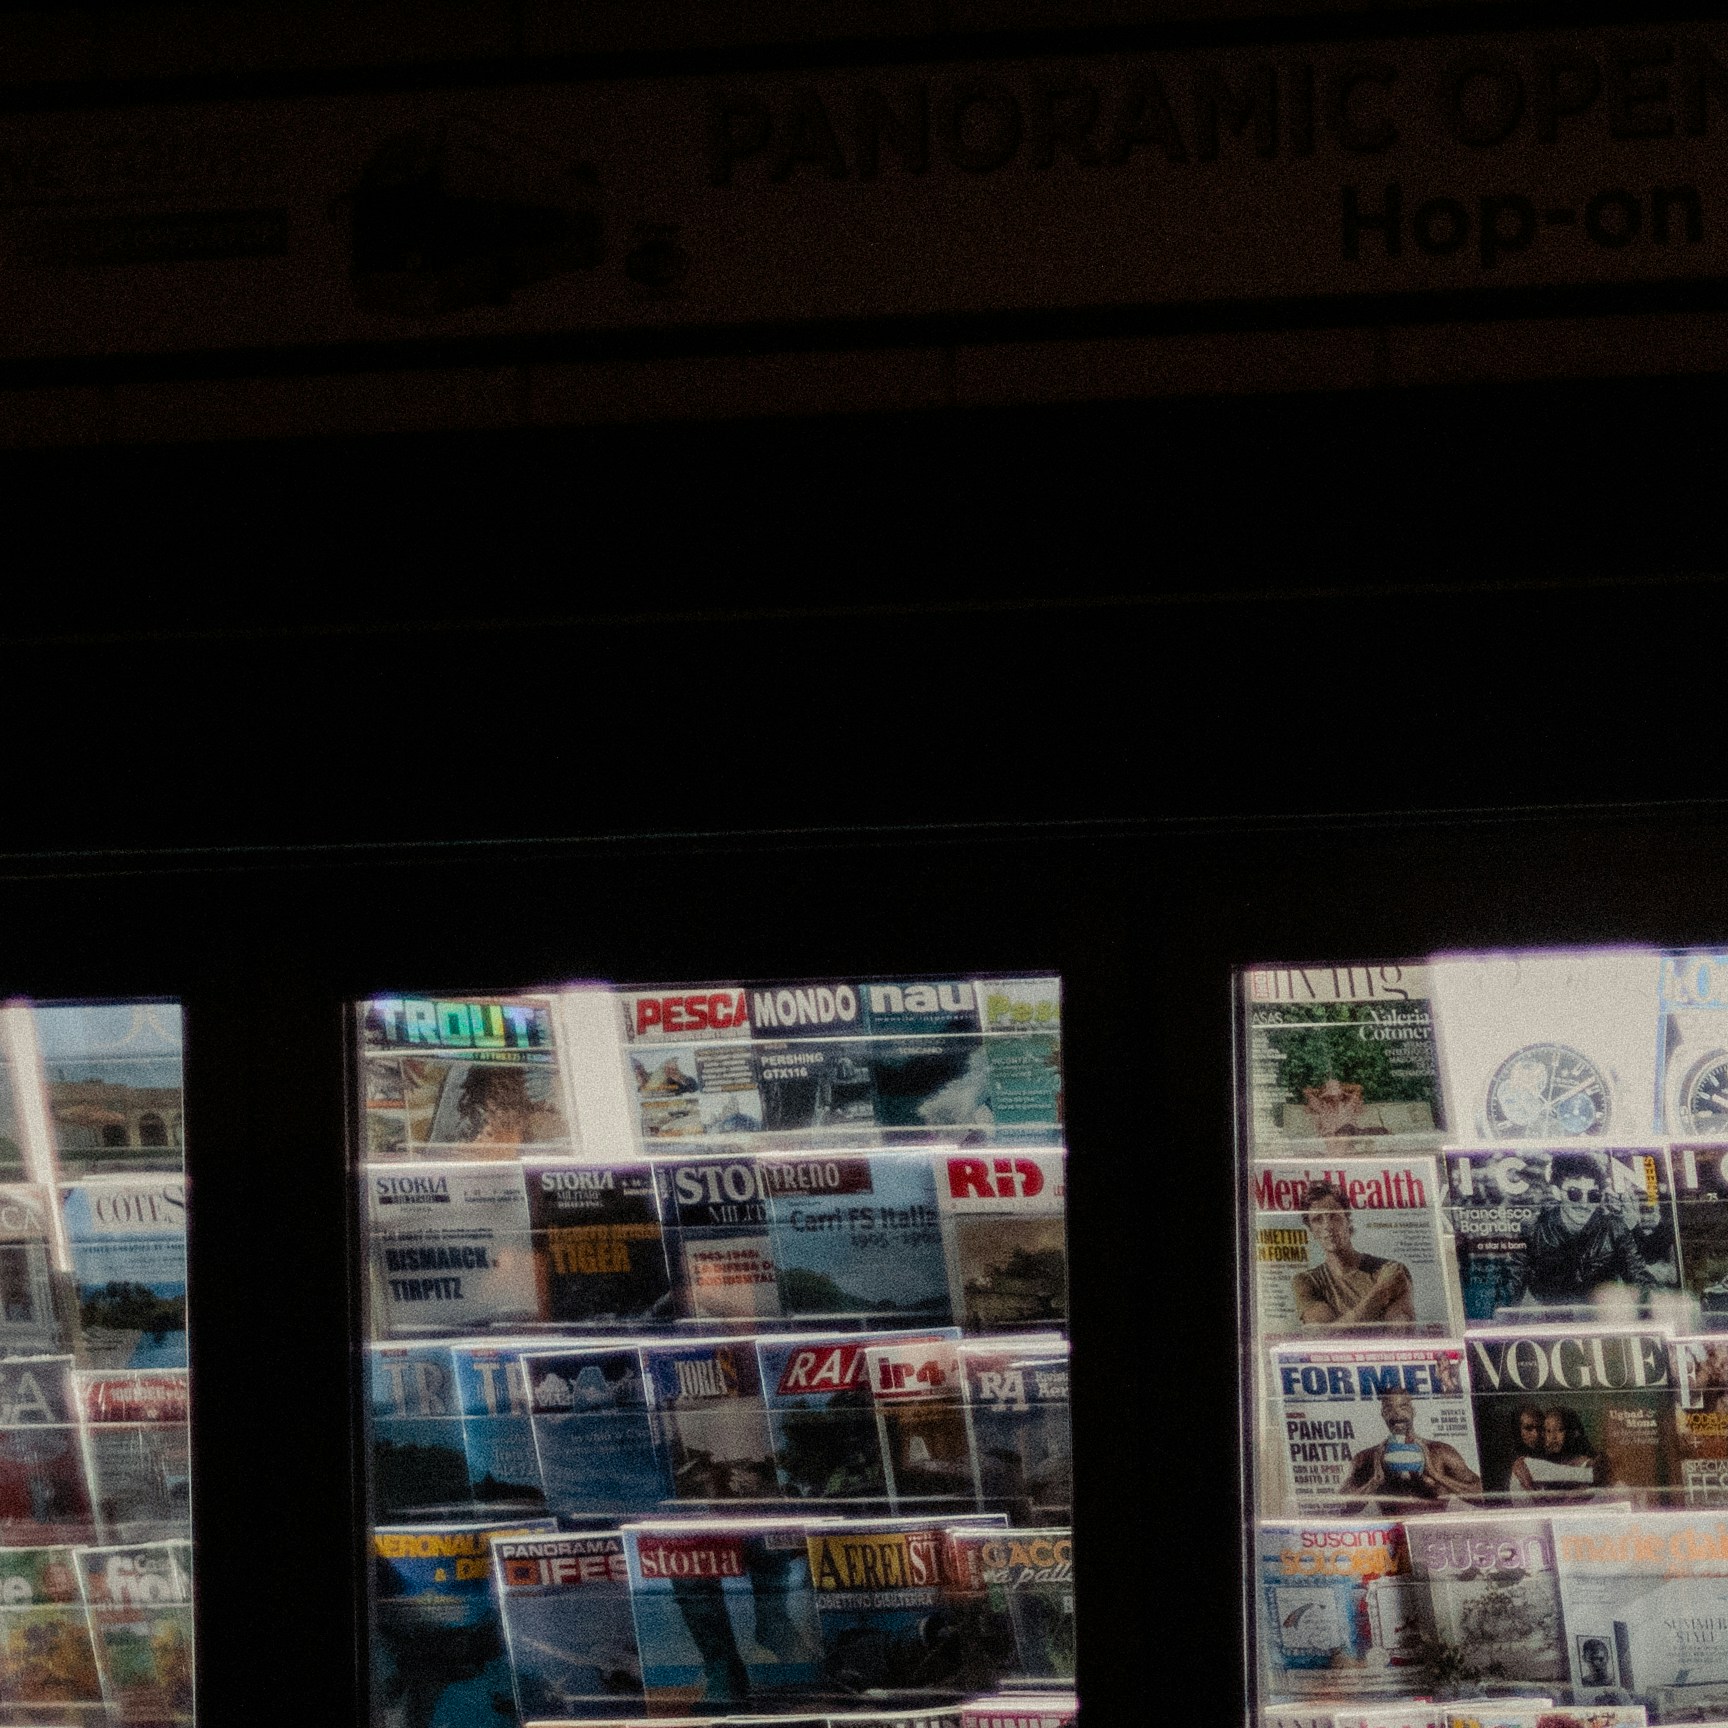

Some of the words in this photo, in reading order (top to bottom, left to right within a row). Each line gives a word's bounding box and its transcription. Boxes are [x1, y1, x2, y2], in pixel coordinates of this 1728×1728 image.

[708, 56, 1400, 186] PANORAMIC
[1341, 178, 1703, 268] Hop-on
[753, 983, 858, 1030] MONDO
[376, 1176, 448, 1195] STORIA
[541, 1170, 615, 1192] STORIA
[385, 1247, 488, 1272] BISMARCK
[551, 1242, 632, 1274] TIGER
[389, 1277, 464, 1301] TIRPITZ
[1474, 1336, 1668, 1391] VOGUE
[1287, 1420, 1354, 1441] PANCIA
[1290, 1442, 1353, 1463] PIATTA
[502, 1538, 618, 1559] PANORAMA
[641, 1542, 740, 1578] storia
